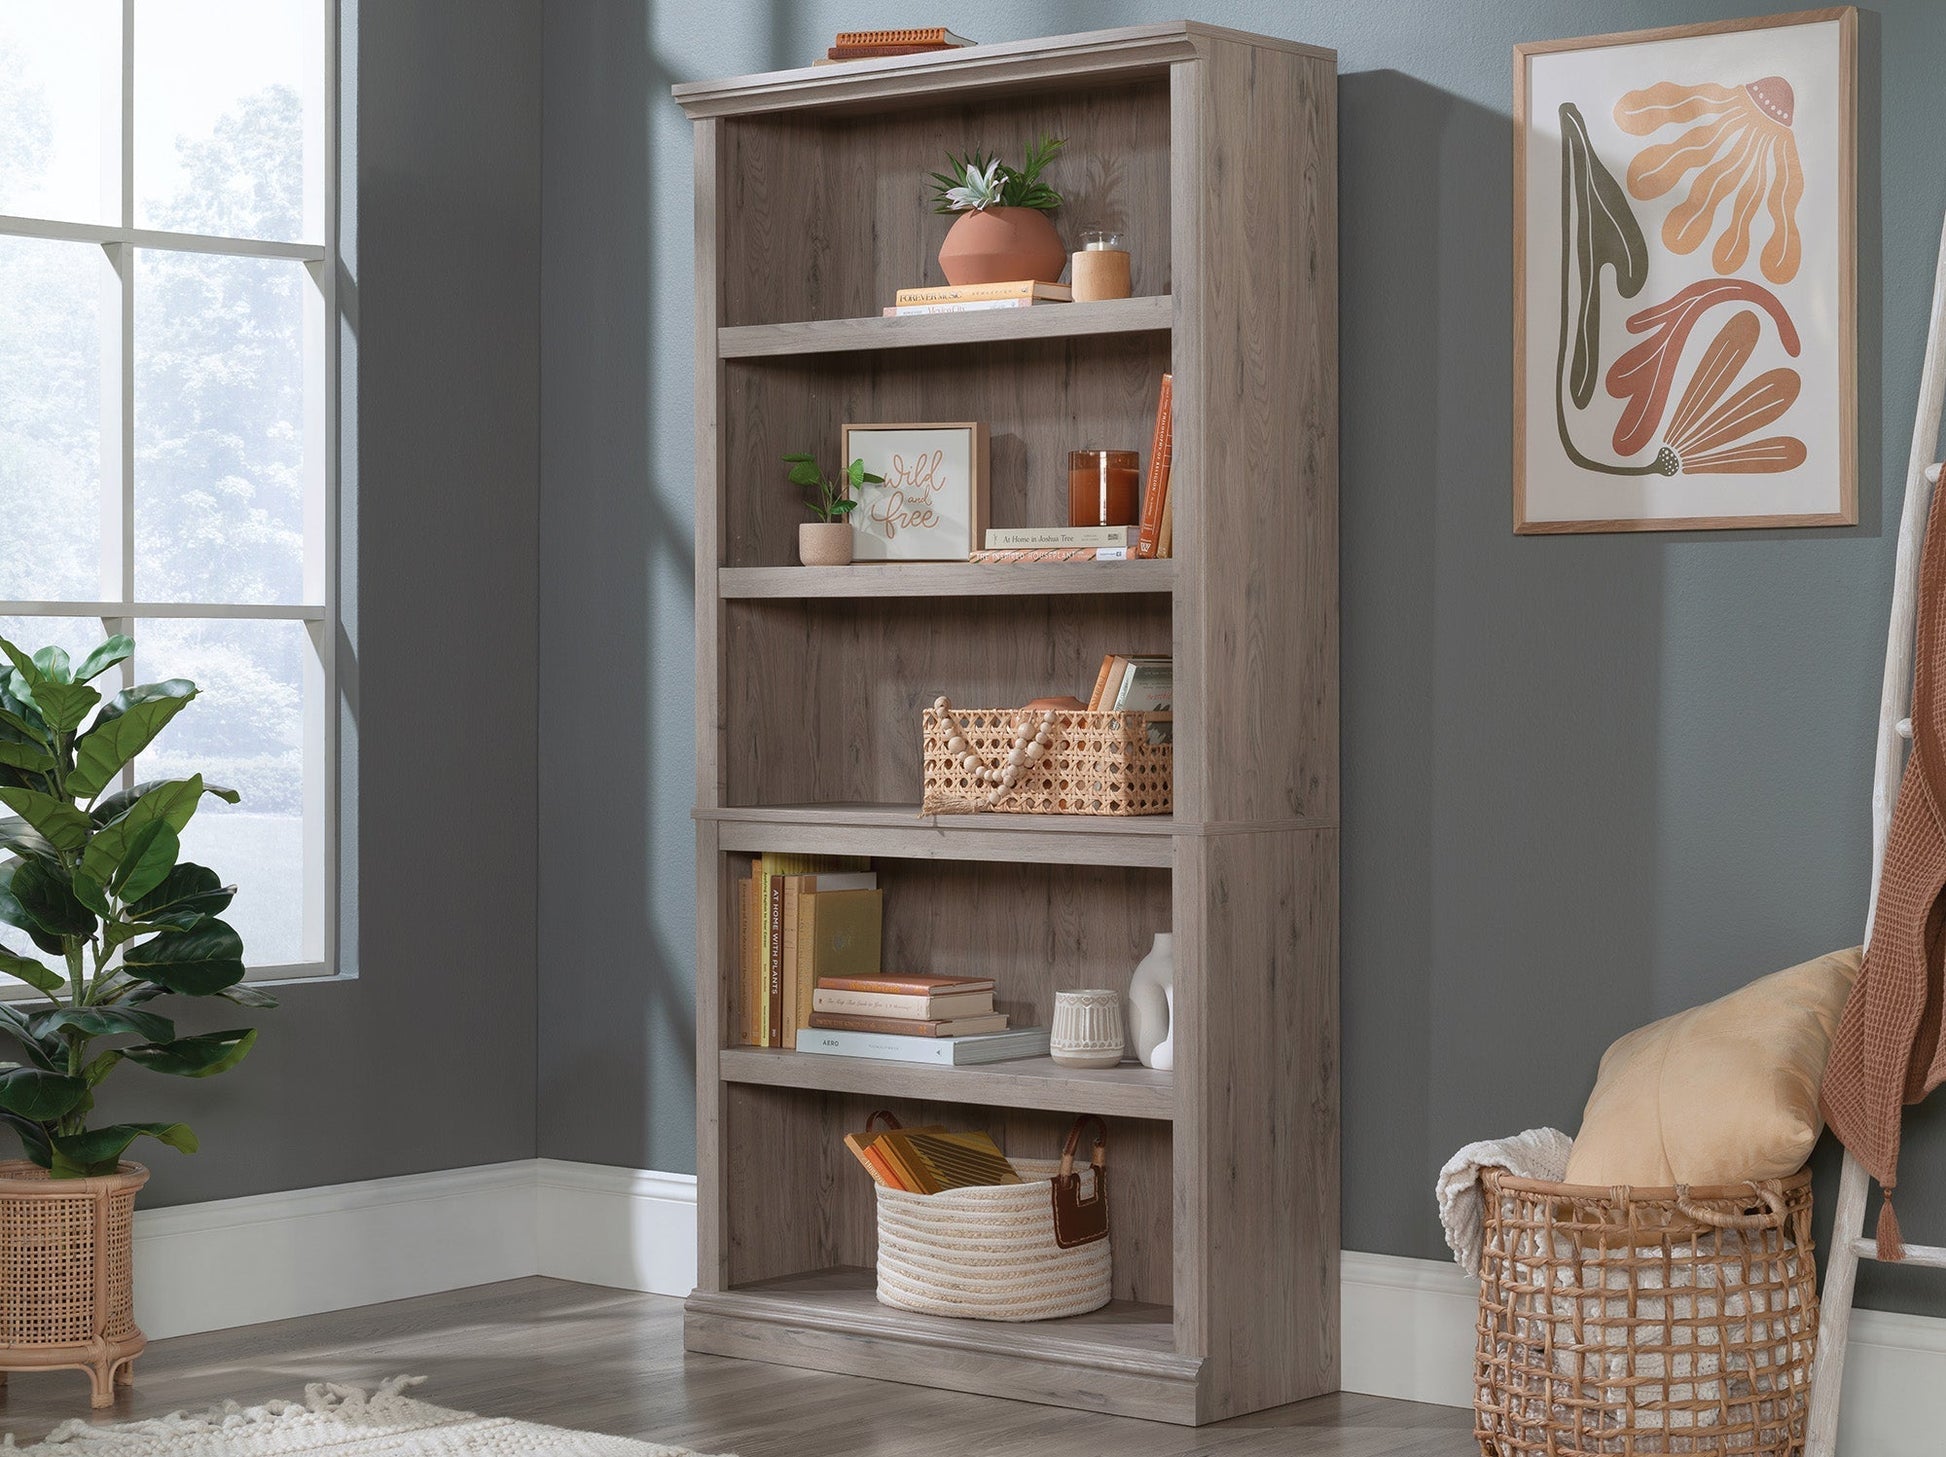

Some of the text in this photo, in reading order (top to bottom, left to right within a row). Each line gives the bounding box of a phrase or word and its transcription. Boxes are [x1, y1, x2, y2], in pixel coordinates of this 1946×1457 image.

[899, 293, 937, 303] FOREVER
[1159, 412, 1167, 450] PHILOSOPHY
[883, 449, 946, 492] wild
[1152, 461, 1160, 490] RELIGION
[907, 486, 932, 506] and
[871, 490, 939, 539] free
[1003, 535, 1011, 543] At
[1012, 535, 1030, 543] Home
[1031, 535, 1037, 543] in
[1038, 534, 1059, 543] Joshua
[1061, 534, 1074, 542] Tree
[772, 889, 779, 902] AT
[822, 1039, 839, 1047] AERO
